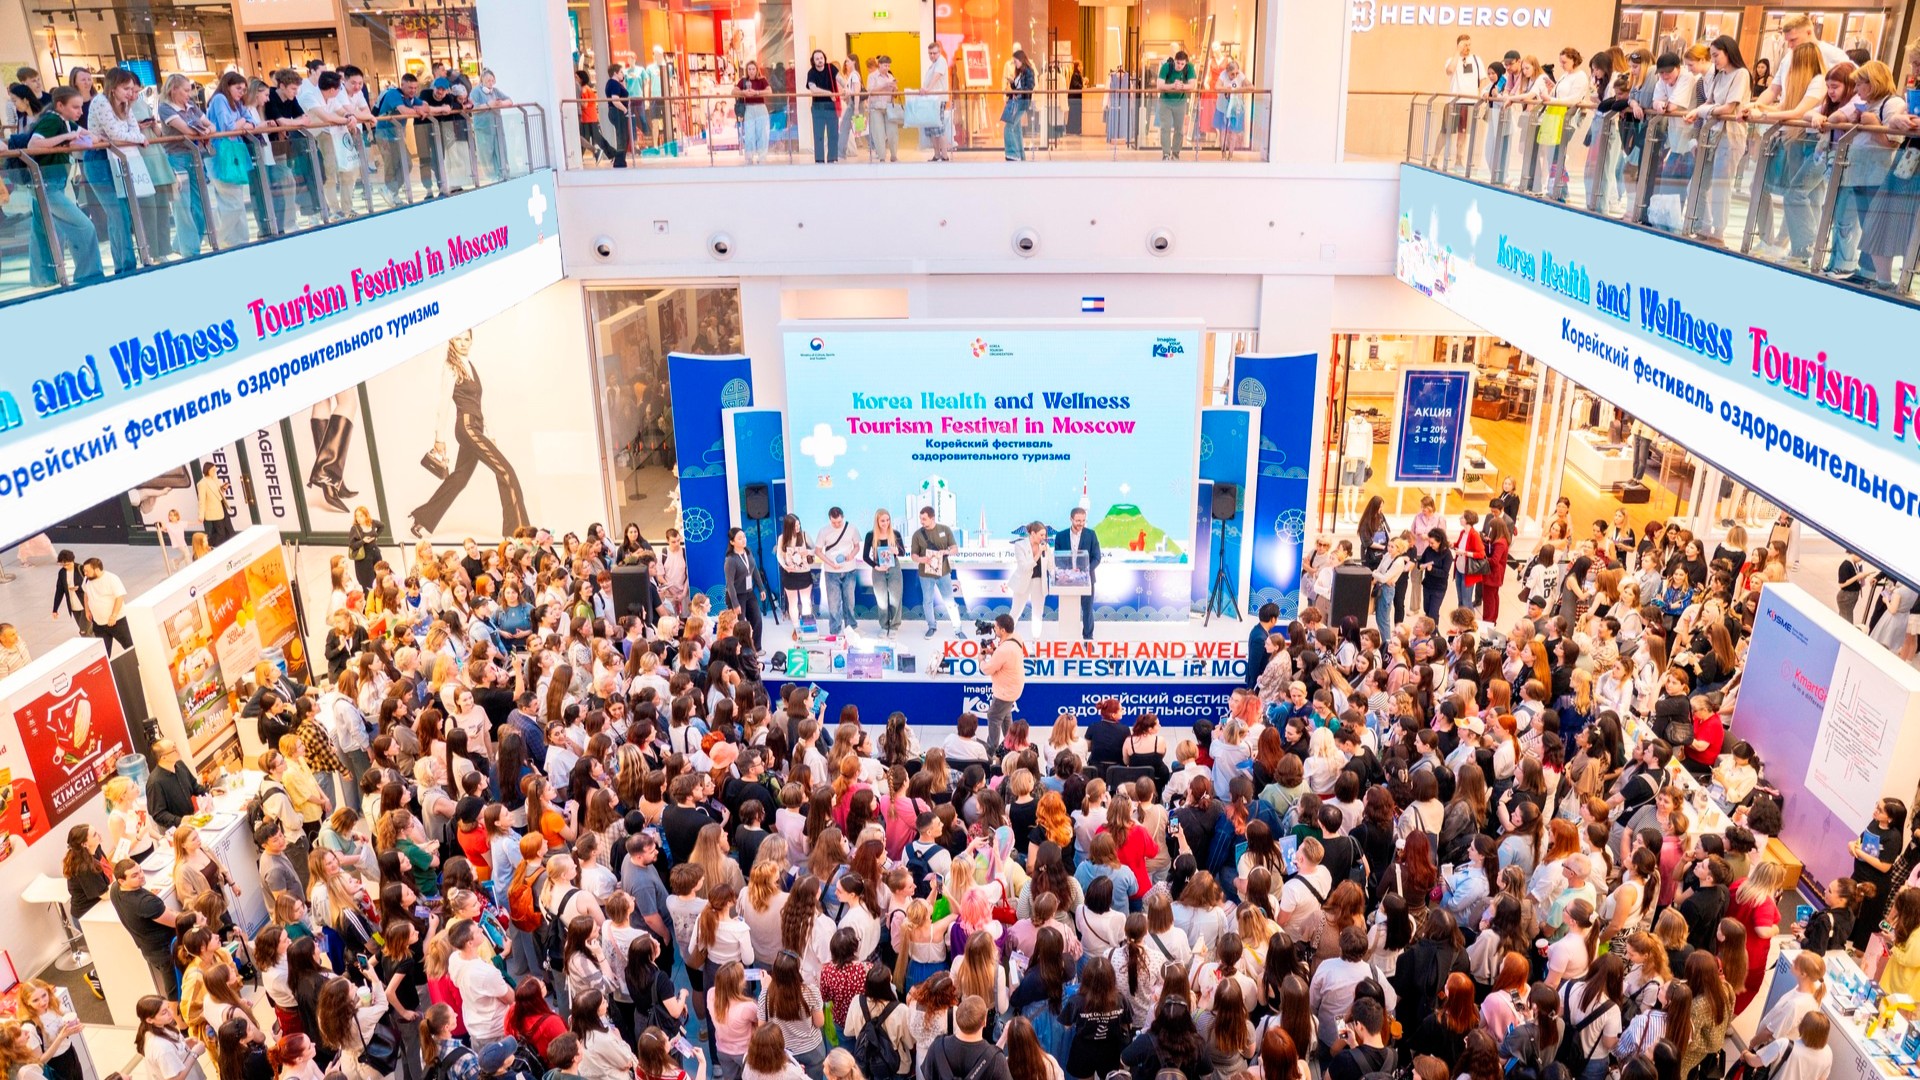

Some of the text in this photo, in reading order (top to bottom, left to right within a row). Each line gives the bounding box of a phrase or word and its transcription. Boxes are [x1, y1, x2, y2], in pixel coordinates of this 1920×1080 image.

[1380, 5, 1552, 28] HENDERSON
[32, 354, 104, 418] and
[109, 319, 240, 390] Wellness
[247, 283, 348, 341] Tourism
[350, 258, 424, 304] Festival
[425, 246, 445, 278] in
[447, 225, 509, 269] Moscow
[1496, 233, 1536, 281] Korea
[1540, 249, 1591, 305] Health
[1596, 279, 1631, 322] and
[1640, 286, 1734, 366] Wellness
[1749, 326, 1880, 430] Tourism
[1561, 316, 1629, 372] Корейский
[1633, 357, 1714, 414] фестиваль
[0, 300, 440, 498] орейский фестиваль оздоровительного туризма
[852, 391, 1130, 410] Korea Health and Wellness
[1414, 407, 1452, 419] АКЦИЯ
[846, 416, 1136, 435] Tourism Festival in Moscow
[1415, 426, 1421, 434] 2
[1430, 426, 1448, 434] 20%
[925, 437, 1053, 451] Корейский фестиваль
[1414, 436, 1420, 444] 3
[1429, 436, 1447, 444] 30%
[912, 452, 1071, 463] оздоровительного туризма
[257, 429, 285, 518] AGERFELD
[951, 551, 996, 559] етрополис
[1036, 641, 1129, 659] HEALTH
[1135, 641, 1187, 659] AND
[1063, 659, 1176, 677] FESTIVAL
[1183, 659, 1203, 677] in
[963, 685, 994, 694] Imagin
[1795, 667, 1828, 703] KmartGr
[1173, 694, 1231, 705] ФЕСТИВ
[53, 771, 95, 808] KIMCHI
